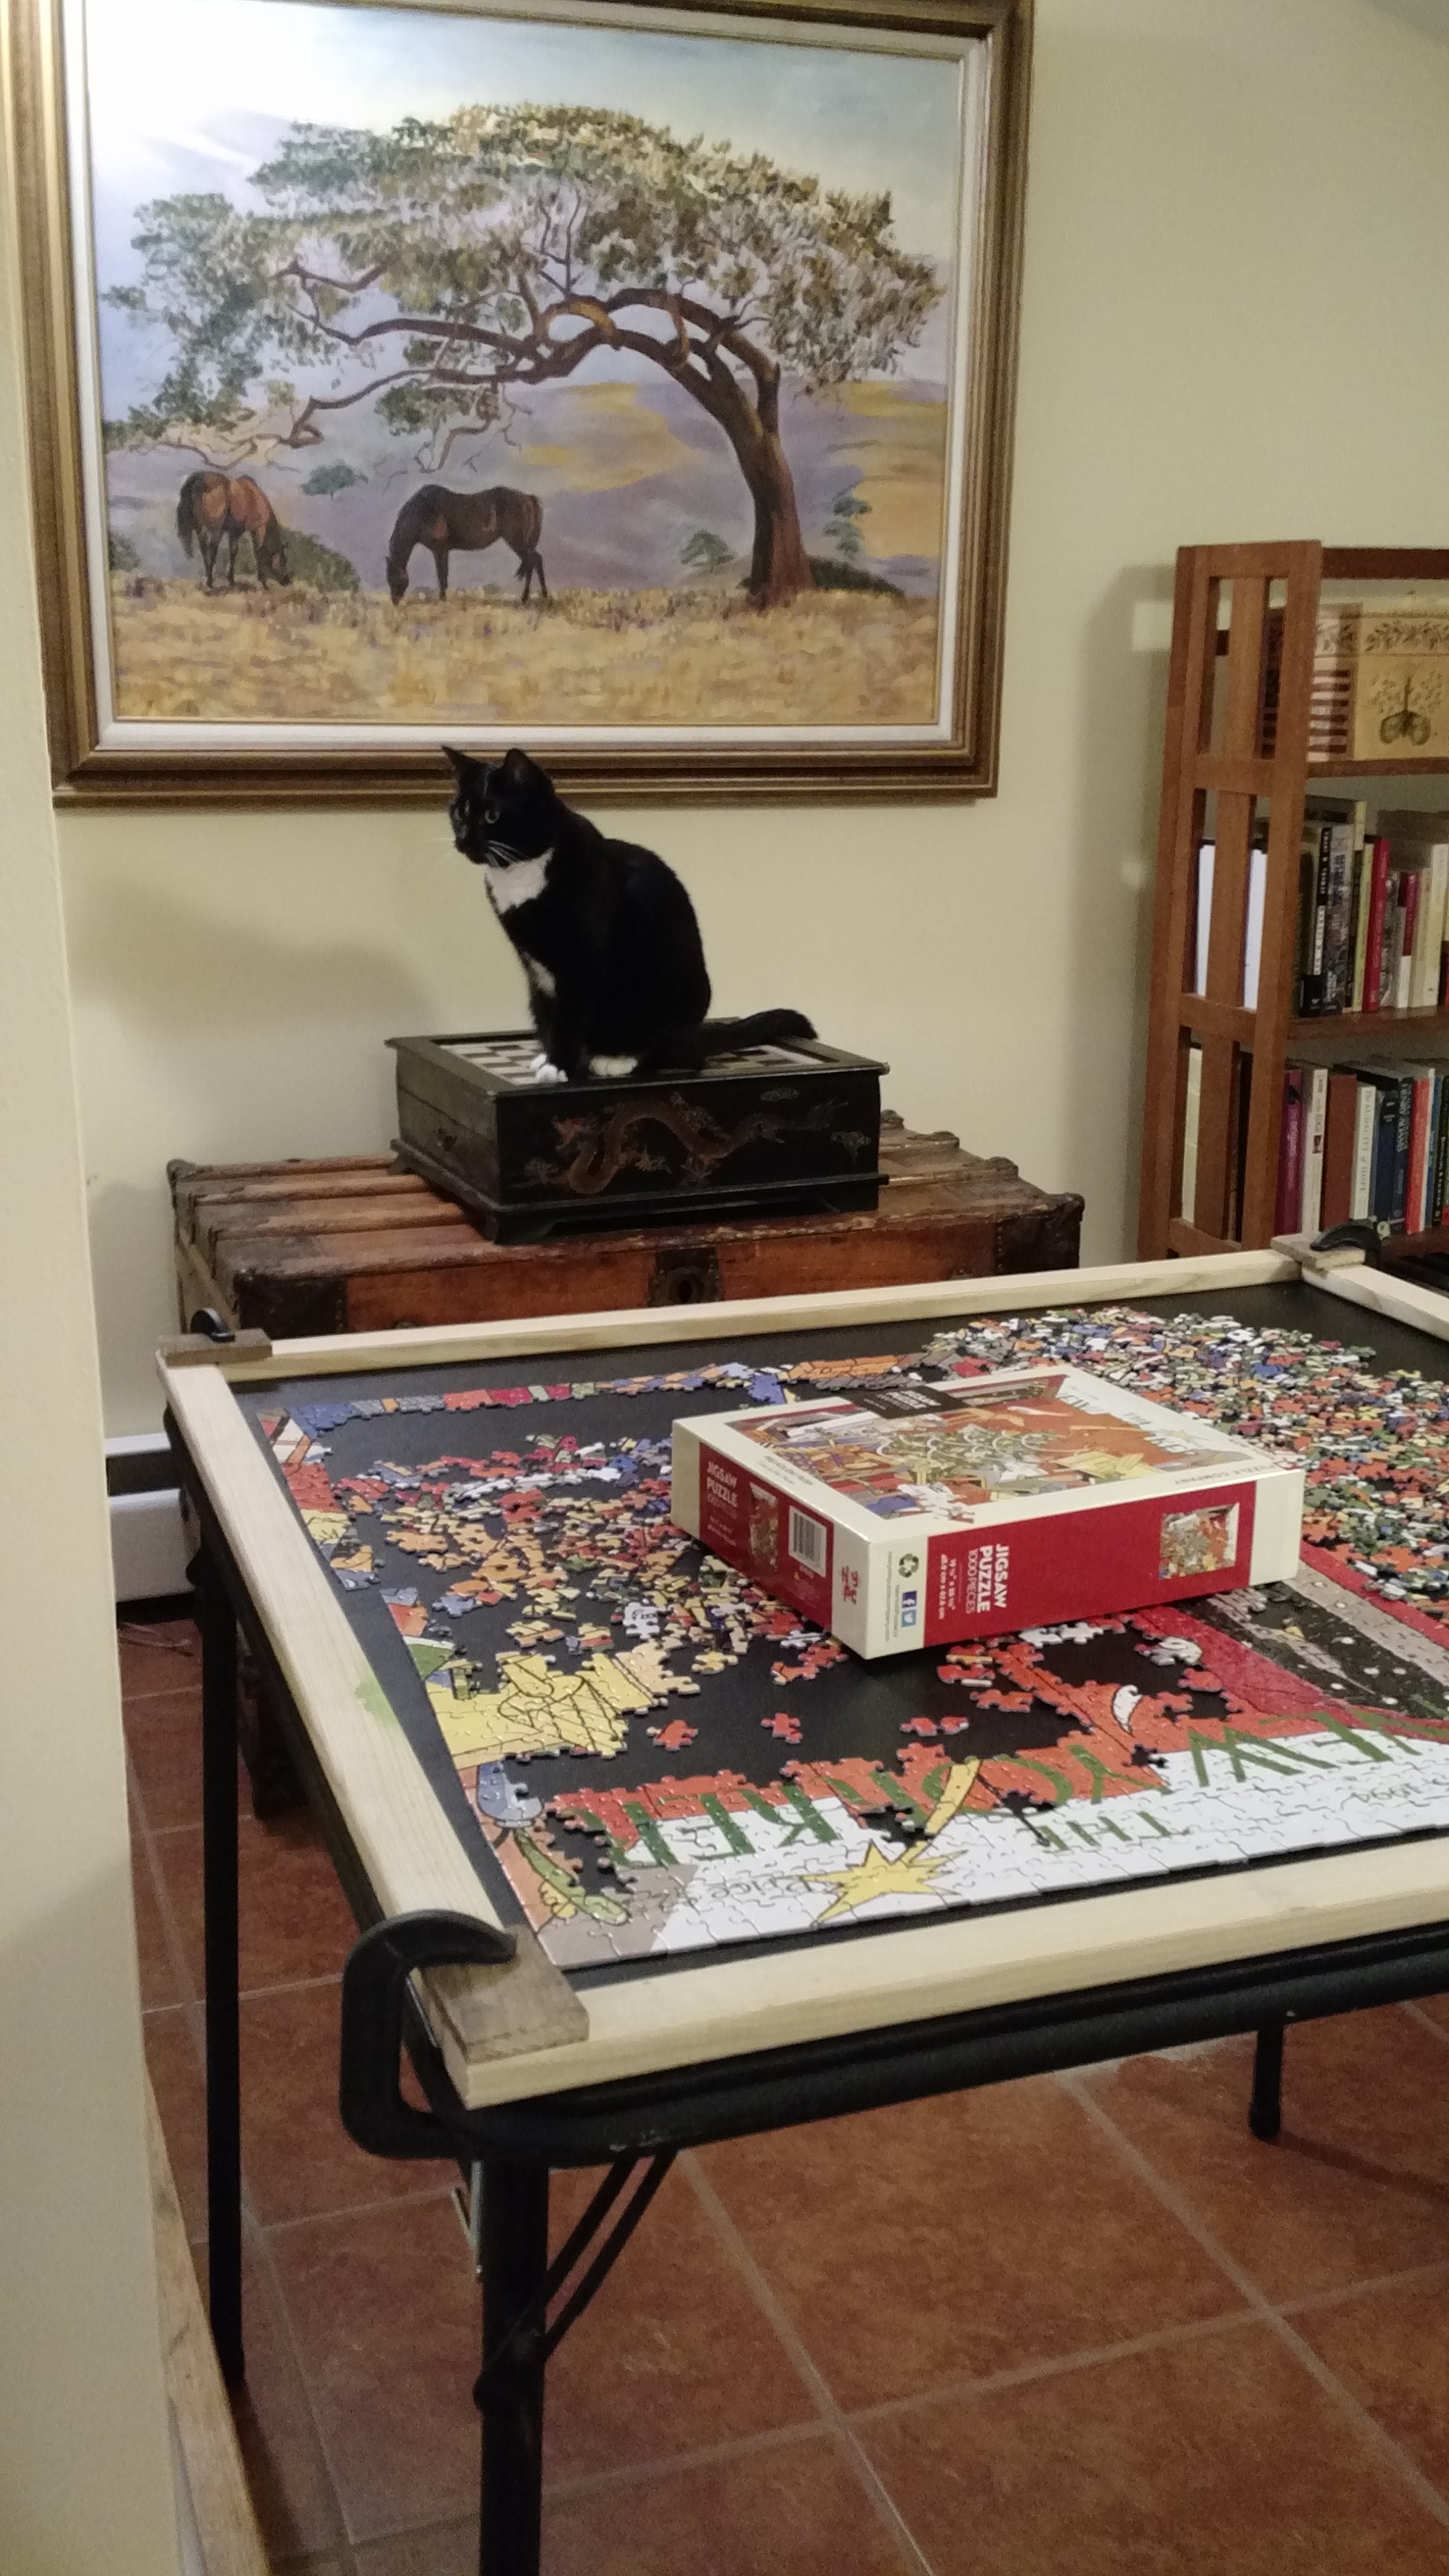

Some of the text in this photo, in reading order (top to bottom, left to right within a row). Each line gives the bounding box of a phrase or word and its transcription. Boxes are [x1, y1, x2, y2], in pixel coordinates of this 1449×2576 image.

[706, 1477, 738, 1507] PUZZLE
[707, 1461, 738, 1489] JIGSAW
[966, 1549, 977, 1614] 1000 PIECES
[978, 1545, 993, 1612] PUZZLE
[995, 1543, 1010, 1608] JIGSAW
[1016, 1811, 1190, 1858] THE
[708, 1876, 814, 1902] Price
